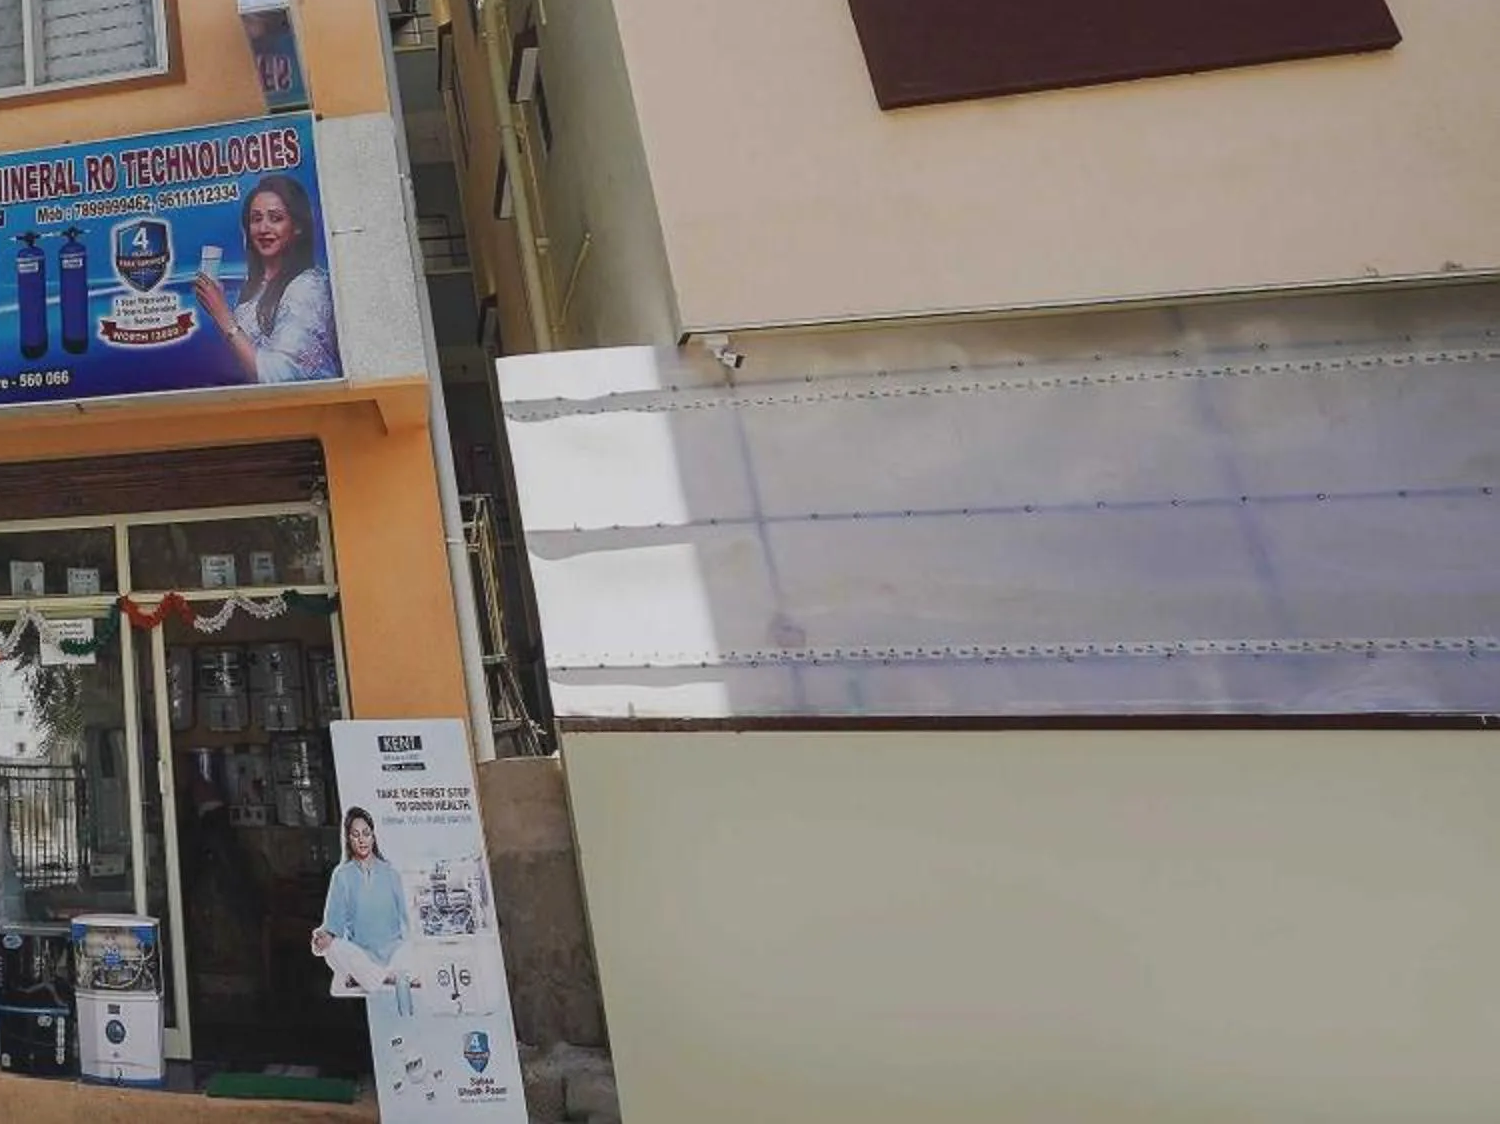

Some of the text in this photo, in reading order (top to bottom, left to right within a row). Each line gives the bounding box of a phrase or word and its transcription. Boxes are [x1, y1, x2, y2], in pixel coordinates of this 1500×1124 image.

[85, 154, 116, 193] RO
[121, 128, 300, 188] TECHNOLOGIES
[132, 228, 149, 250] 4
[19, 373, 42, 388] 560
[45, 370, 69, 385] 066
[383, 736, 415, 750] KENT
